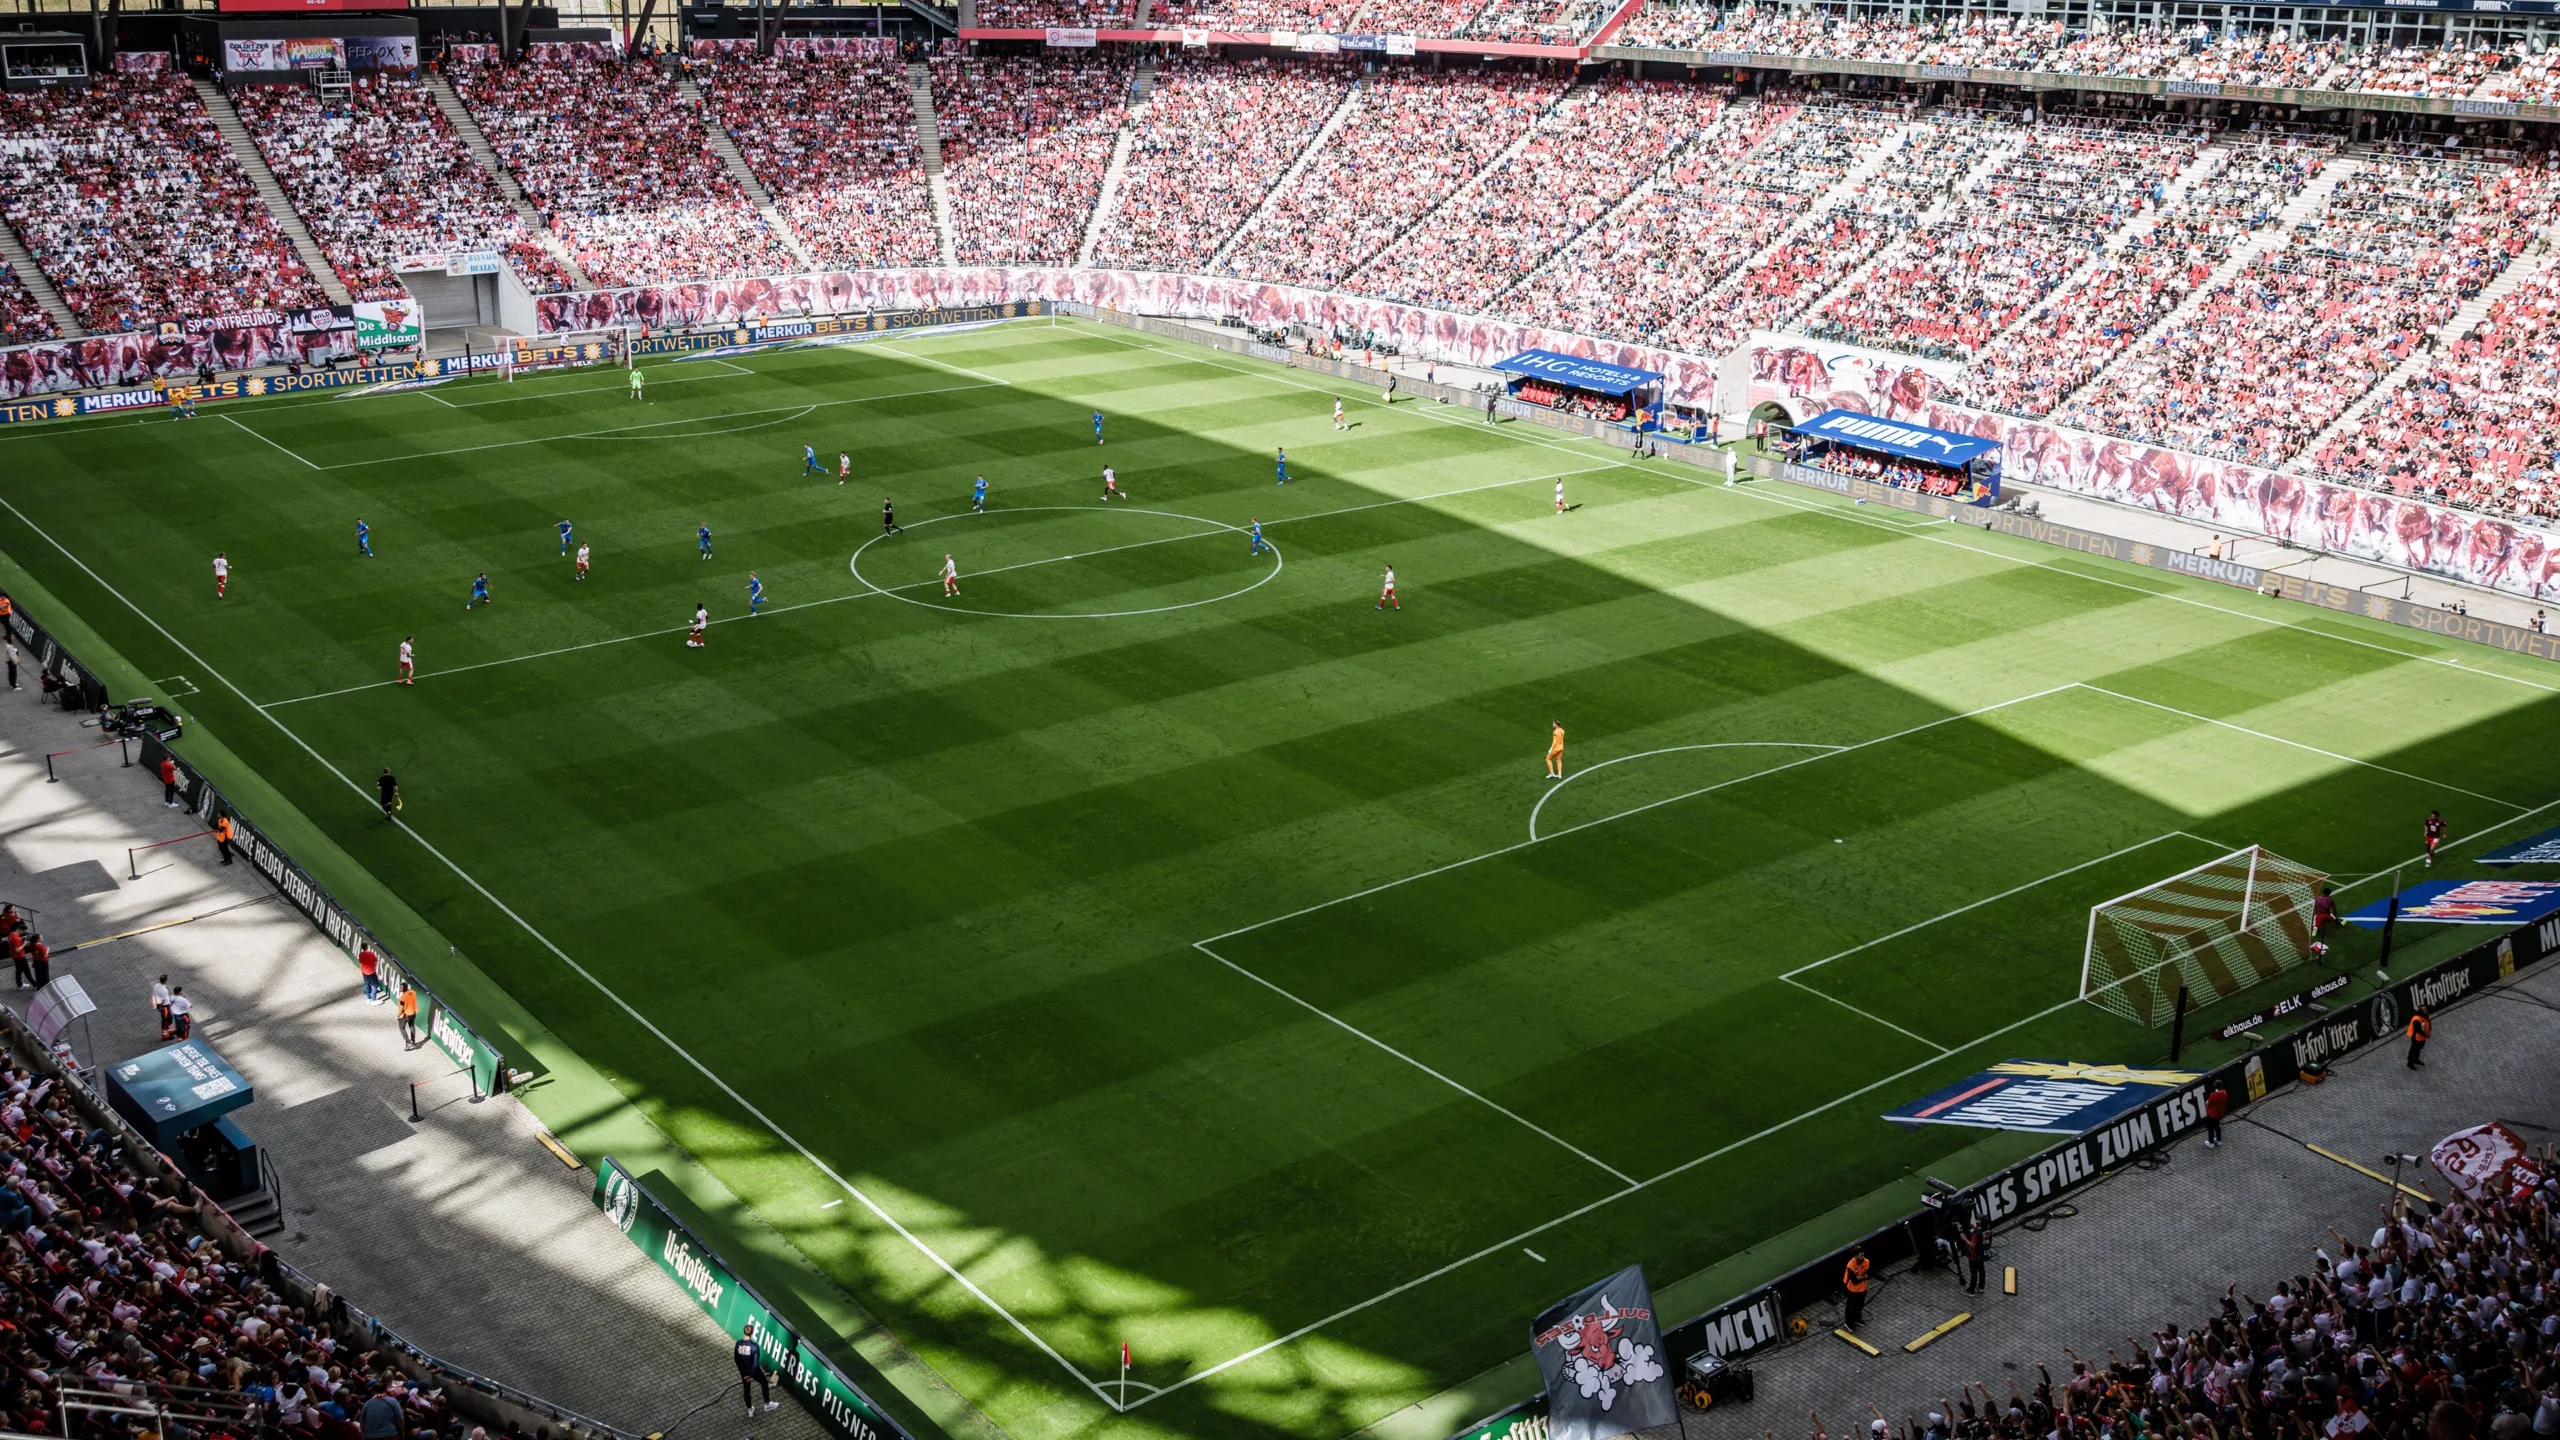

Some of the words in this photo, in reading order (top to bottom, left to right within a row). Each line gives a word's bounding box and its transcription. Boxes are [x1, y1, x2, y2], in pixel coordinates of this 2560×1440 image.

[1611, 48, 1690, 62] SPORTWETTEN
[1708, 53, 1749, 64] MERKUR
[1752, 57, 1790, 66] BETS
[1812, 60, 1899, 75] SPORTWETTEN
[1921, 66, 1968, 78] MERKUR
[1971, 70, 2016, 82] BETS
[2039, 74, 2142, 93] SPORTWETTEN
[2166, 82, 2220, 95] MERKUR
[2223, 86, 2275, 99] BETS
[2303, 91, 2423, 112] SPORTWETTEN
[2453, 101, 2517, 116] MERKUR
[400, 255, 444, 263] TRADITION
[313, 311, 331, 319] WILD
[358, 321, 375, 331] De
[274, 365, 417, 392] SPORTWETTEN
[447, 352, 514, 370] MERKUR
[517, 346, 577, 363] BETS
[607, 333, 729, 355] SPORTWETTEN
[755, 323, 812, 340] MERKUR
[816, 318, 867, 333] BETS
[893, 308, 998, 328] SPORTWETTEN
[359, 334, 418, 346] Middlsaxn
[1512, 353, 1576, 373] IHG
[1579, 365, 1631, 379] HOTELS
[1568, 369, 1631, 386] RESORTS
[1819, 415, 1931, 448] PUMA
[1096, 308, 1129, 324] BETS
[1251, 341, 1291, 362] MERKUR
[1292, 352, 1332, 371] BETS
[1534, 410, 1584, 430] BETS
[1783, 463, 1849, 492] MERKUR
[1852, 480, 1917, 507] BETS
[1961, 507, 2119, 558] SPORTWETTEN
[2167, 551, 2256, 586] MERKUR
[2262, 571, 2349, 605] BETS
[254, 842, 284, 884] HELDEN
[283, 869, 316, 912] STEHEN
[314, 895, 326, 924] ZU
[325, 907, 352, 947] IHRER
[2311, 975, 2348, 999] elkhaus.de
[2280, 994, 2302, 1015] ELK
[2223, 1013, 2263, 1038] elkhaus.de
[2022, 1142, 2094, 1203] SPIEL
[2097, 1113, 2154, 1168] ZUM
[2156, 1085, 2208, 1138] FEST
[747, 1314, 820, 1397] FEINHERBES
